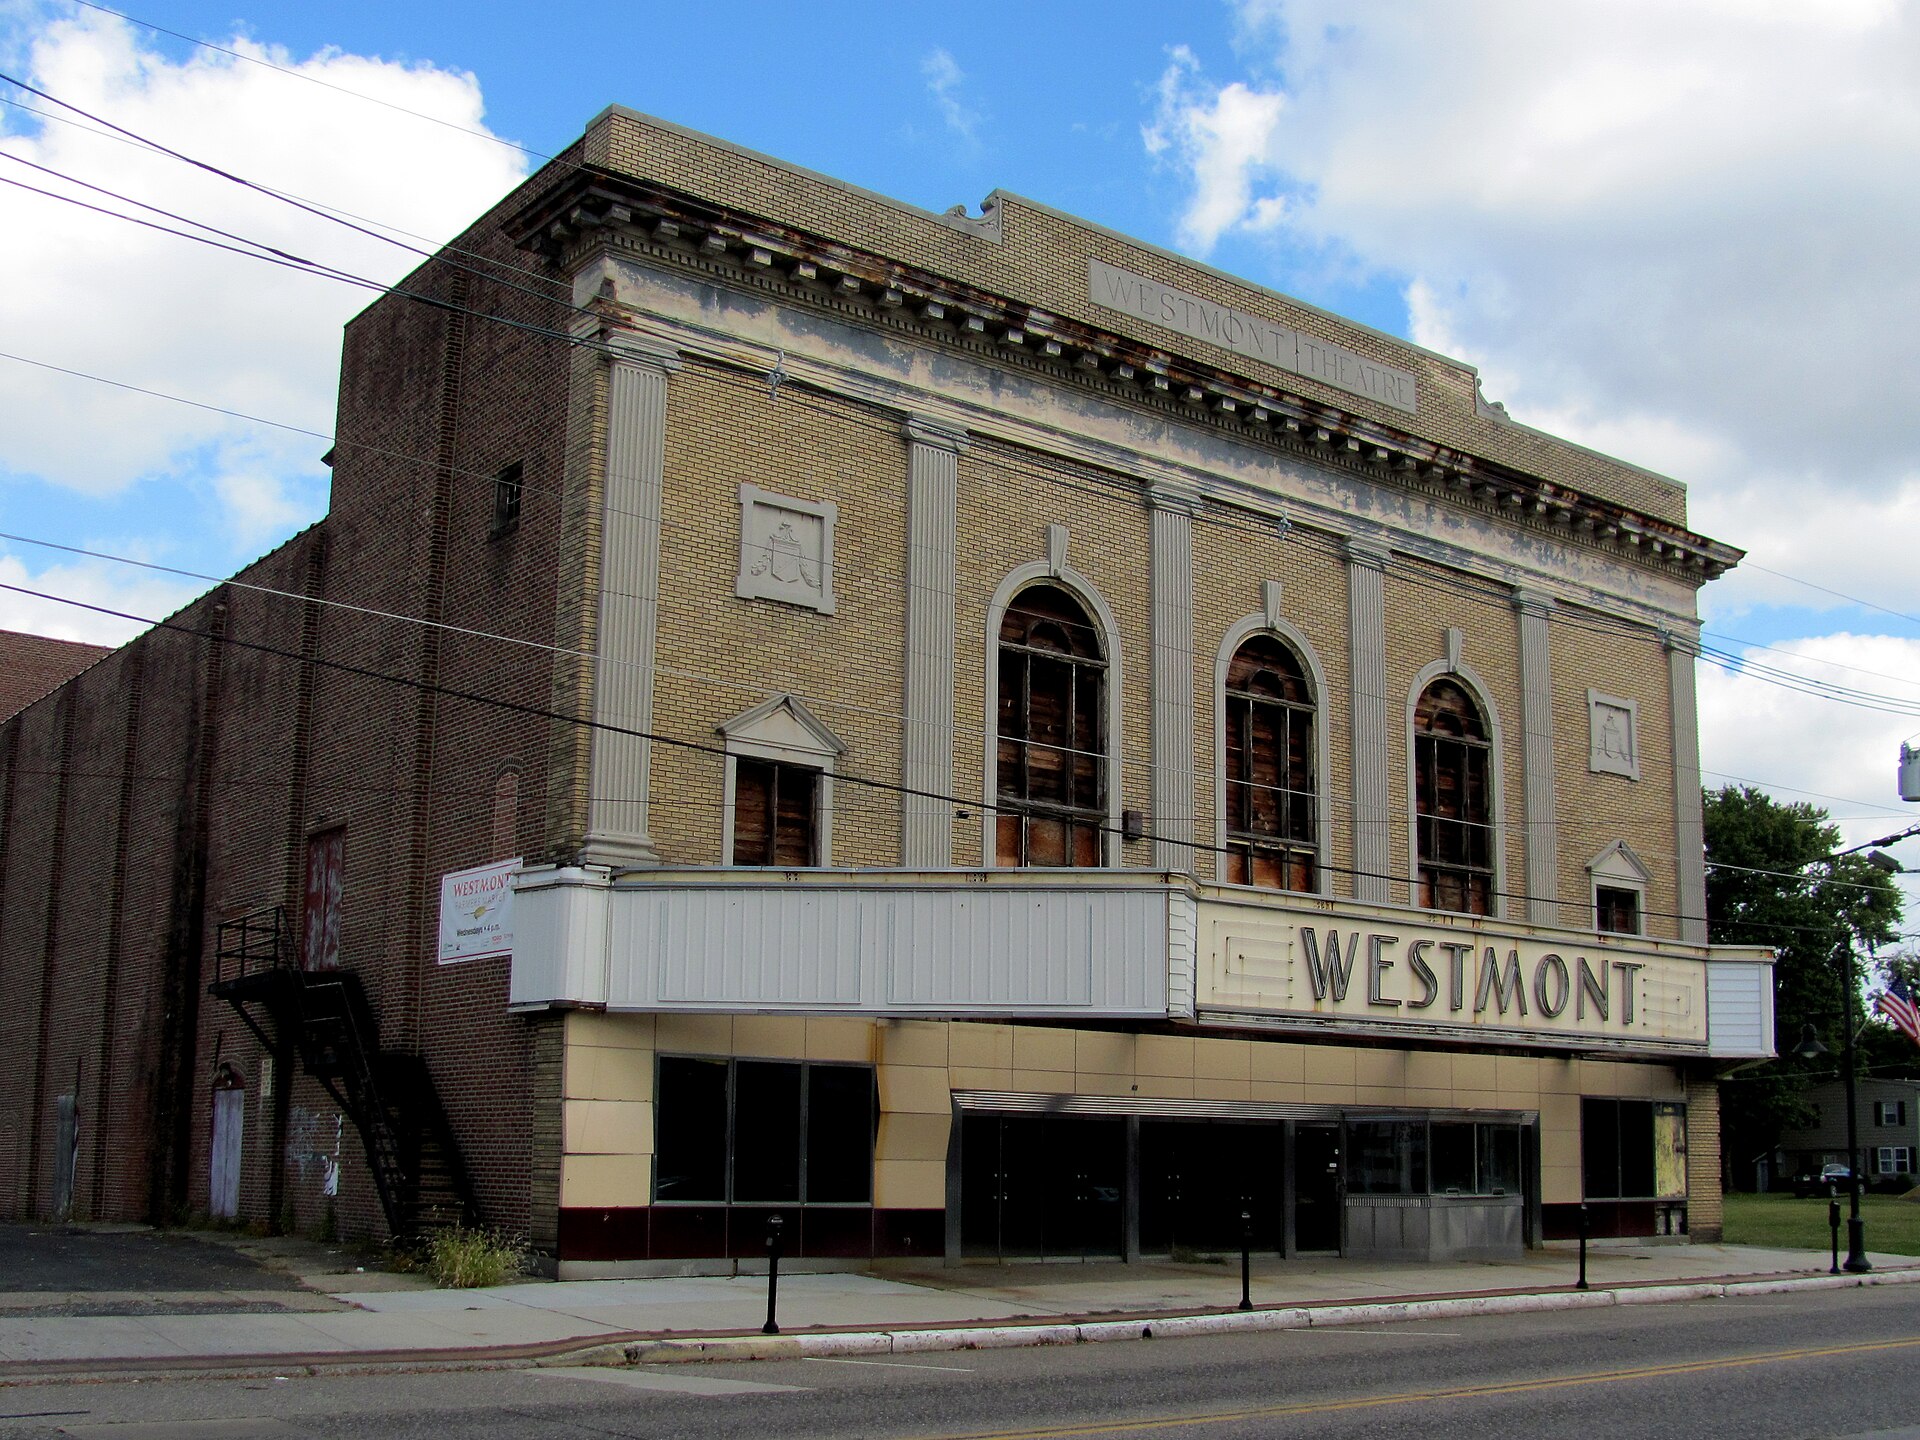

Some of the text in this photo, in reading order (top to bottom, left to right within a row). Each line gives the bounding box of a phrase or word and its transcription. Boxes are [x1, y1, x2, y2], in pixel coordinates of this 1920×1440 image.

[1104, 271, 1410, 406] WESTMONT THEATRE
[454, 872, 512, 897] WESTMONT
[456, 927, 483, 937] Wednesdays
[1300, 927, 1643, 1025] WESTMONT
